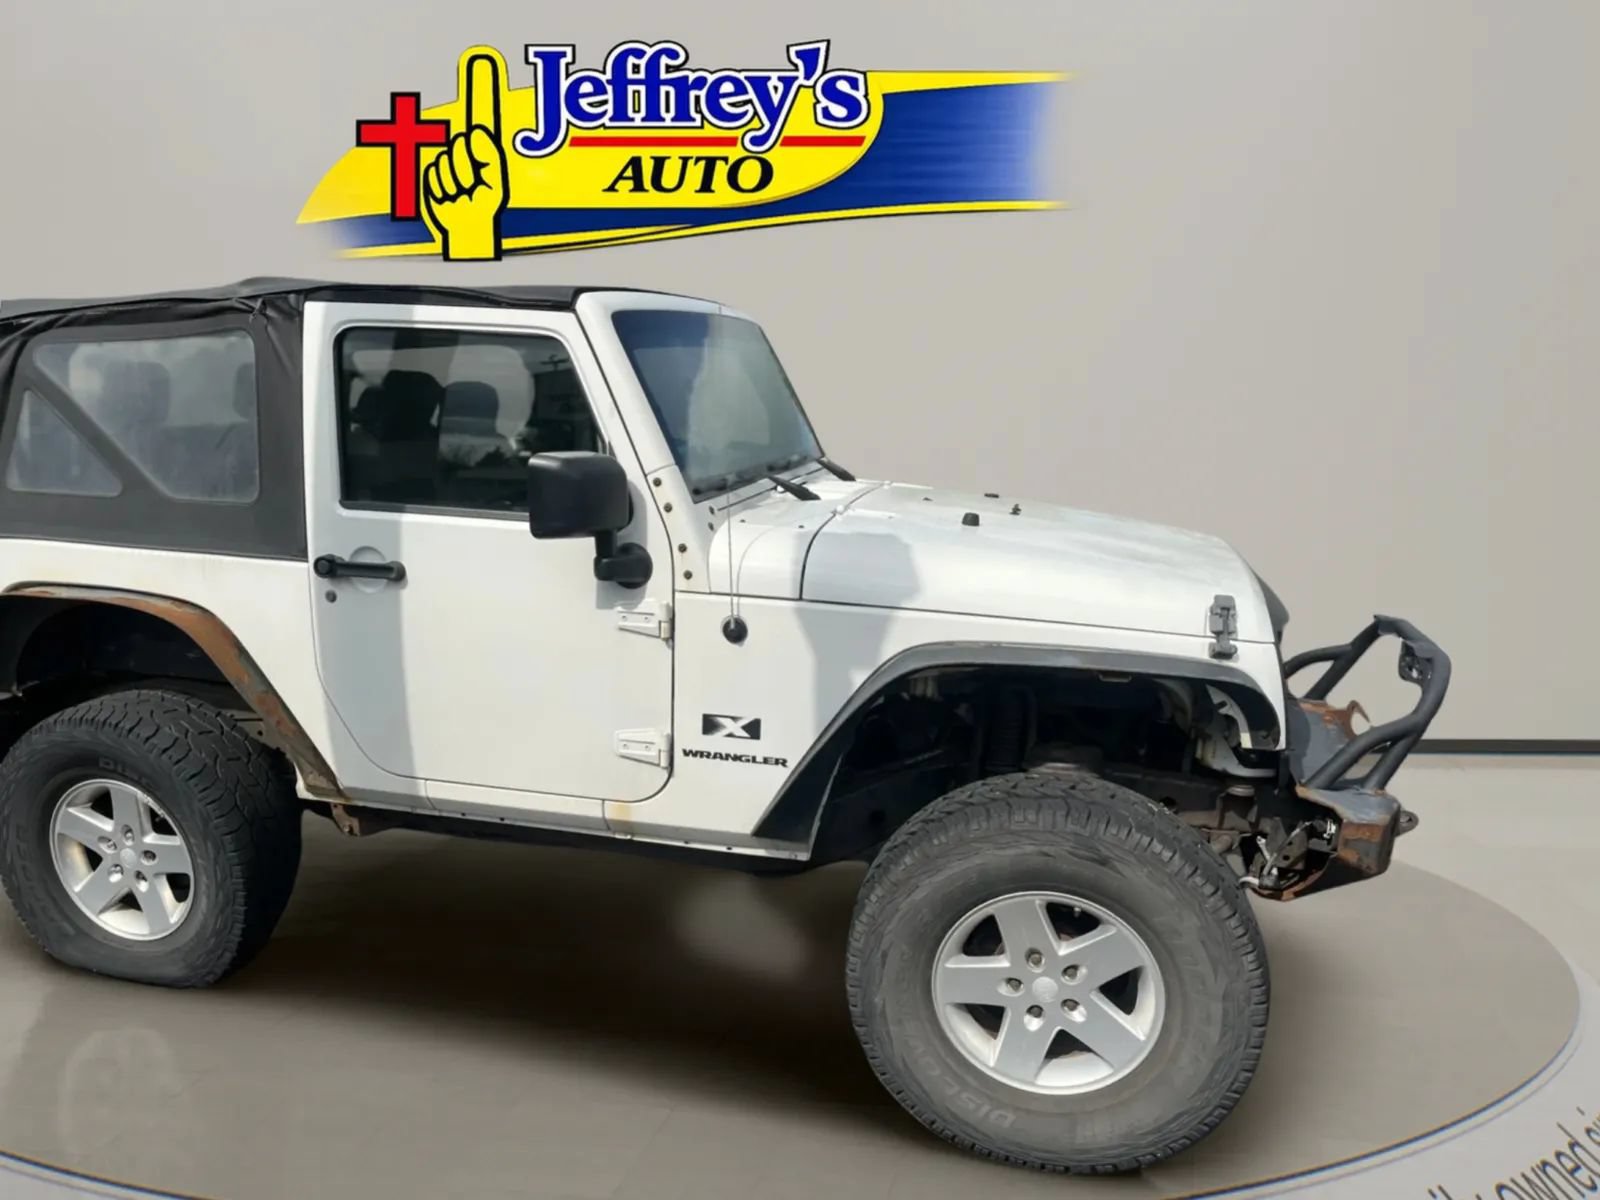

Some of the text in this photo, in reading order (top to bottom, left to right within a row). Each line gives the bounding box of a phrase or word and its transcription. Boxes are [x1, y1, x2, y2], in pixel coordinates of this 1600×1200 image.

[515, 42, 868, 155] Jeffrey's
[603, 156, 773, 193] AUTO
[703, 714, 761, 740] X
[682, 749, 788, 768] WRANGLER
